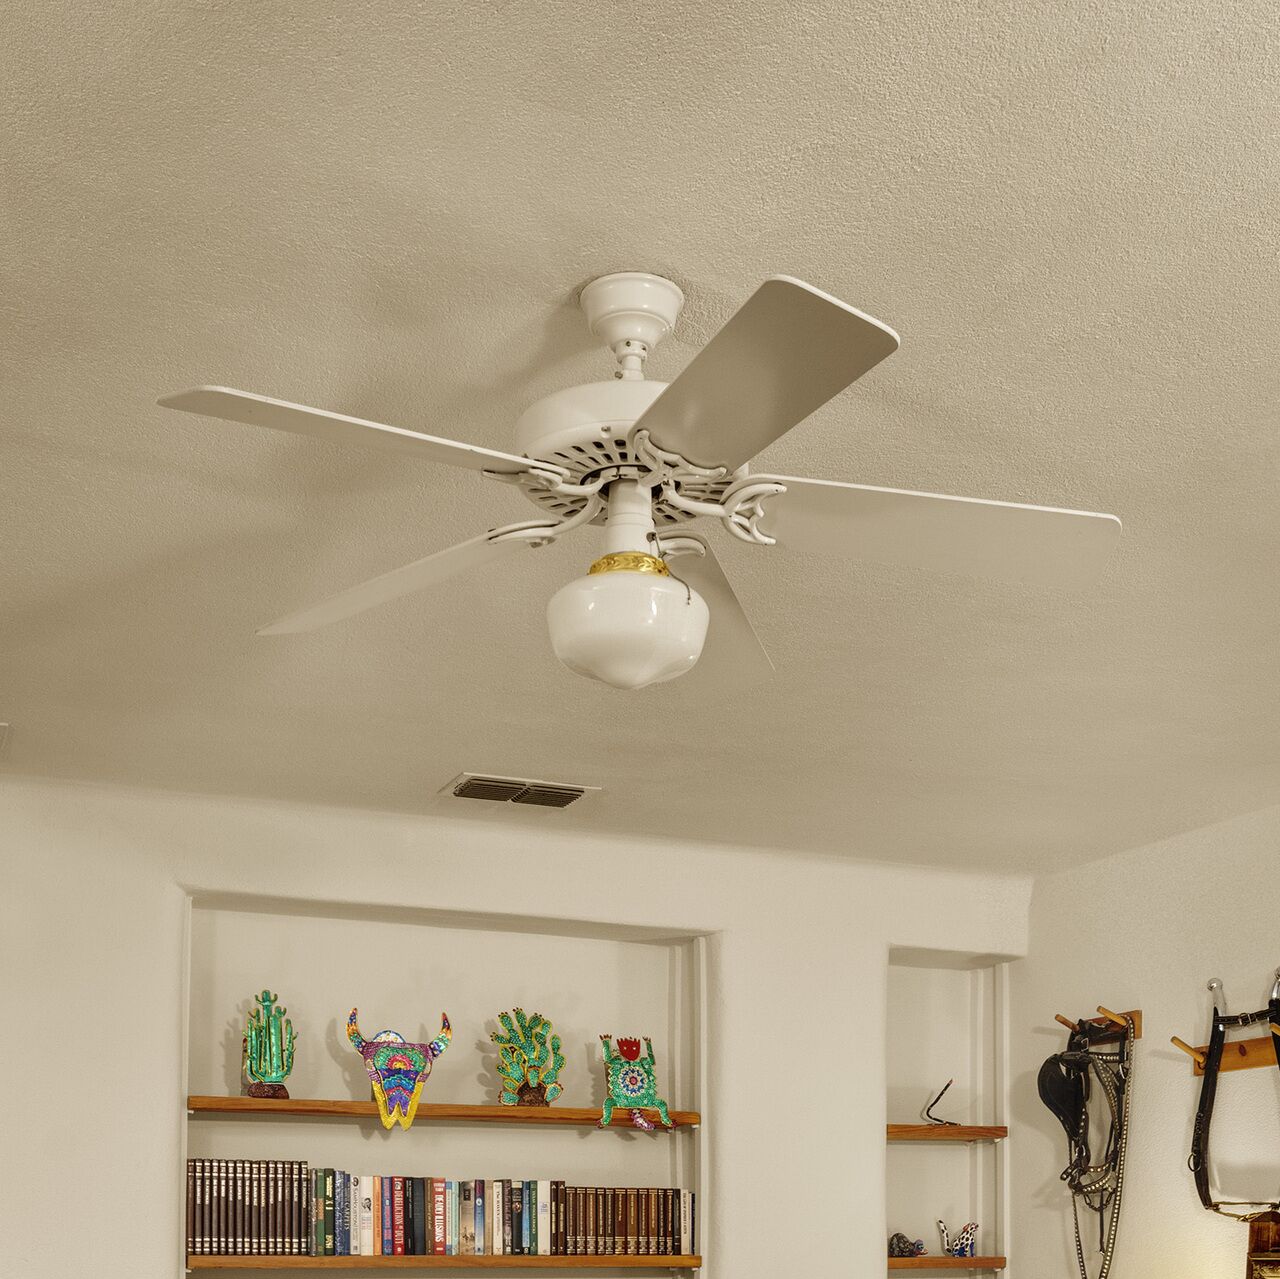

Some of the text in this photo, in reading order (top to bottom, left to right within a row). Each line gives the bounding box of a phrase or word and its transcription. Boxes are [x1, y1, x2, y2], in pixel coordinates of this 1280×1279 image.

[395, 1191, 403, 1225] DERELICTION
[435, 1194, 444, 1214] DEADLY
[395, 1230, 403, 1244] DUTY
[435, 1215, 444, 1243] ILLUSIONS
